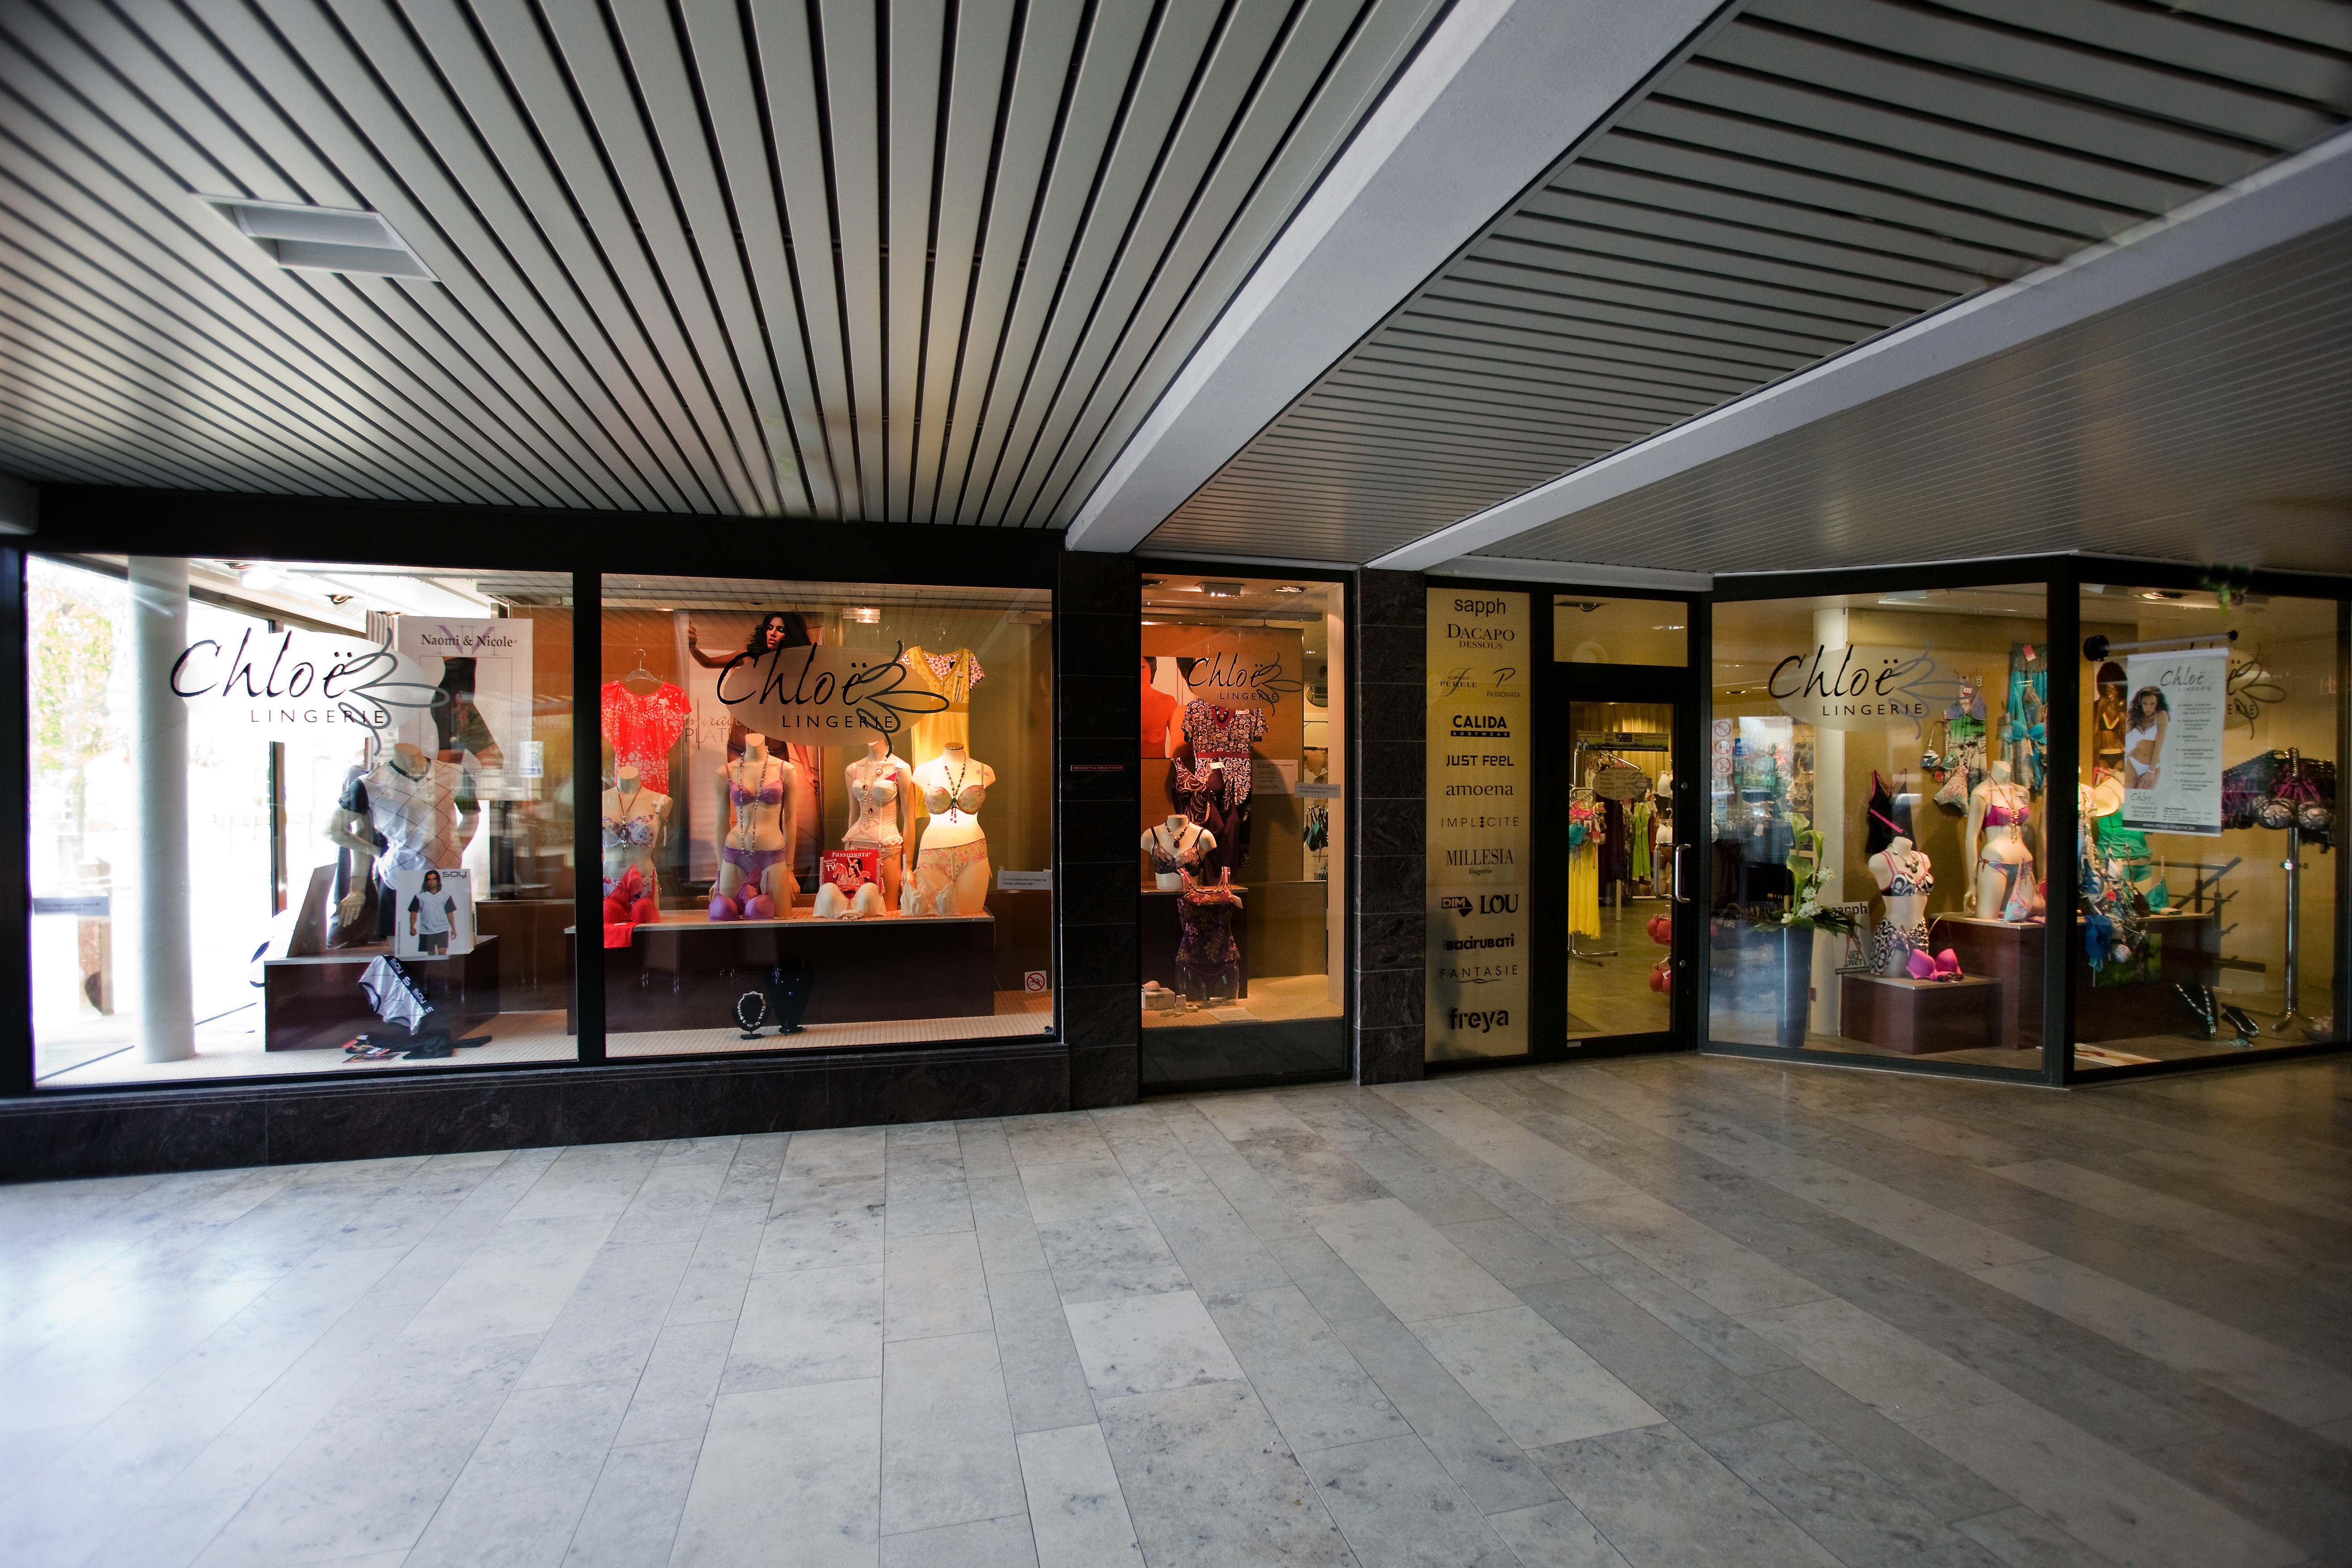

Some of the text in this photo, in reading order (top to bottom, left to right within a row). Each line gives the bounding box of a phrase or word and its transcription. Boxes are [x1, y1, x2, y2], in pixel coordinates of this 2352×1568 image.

[1454, 598, 1506, 617] sapph
[1447, 623, 1514, 642] DACAPO
[421, 634, 460, 646] Naomi
[463, 635, 473, 646] &
[1459, 640, 1503, 650] DESSOUS
[170, 627, 355, 699] Chloë
[716, 641, 869, 706] Chloë
[1186, 652, 1264, 689] Chloë
[1768, 644, 1902, 699] Chloë
[2160, 666, 2206, 686] Chloë
[1219, 692, 1277, 701] LINGERIE
[251, 709, 384, 723] LINGERIE
[1823, 703, 1923, 716] LINGERIE
[782, 715, 894, 729] LINGERIE
[1453, 715, 1508, 729] CALIDA
[1446, 755, 1478, 767] JUST
[1446, 784, 1514, 796] amoena
[1446, 848, 1514, 866] MILLESIA
[826, 864, 836, 872] TV
[1469, 867, 1493, 875] lingerie
[1480, 894, 1519, 915] LOU
[1440, 965, 1518, 979] FANTASIE
[1449, 1008, 1509, 1033] freya
